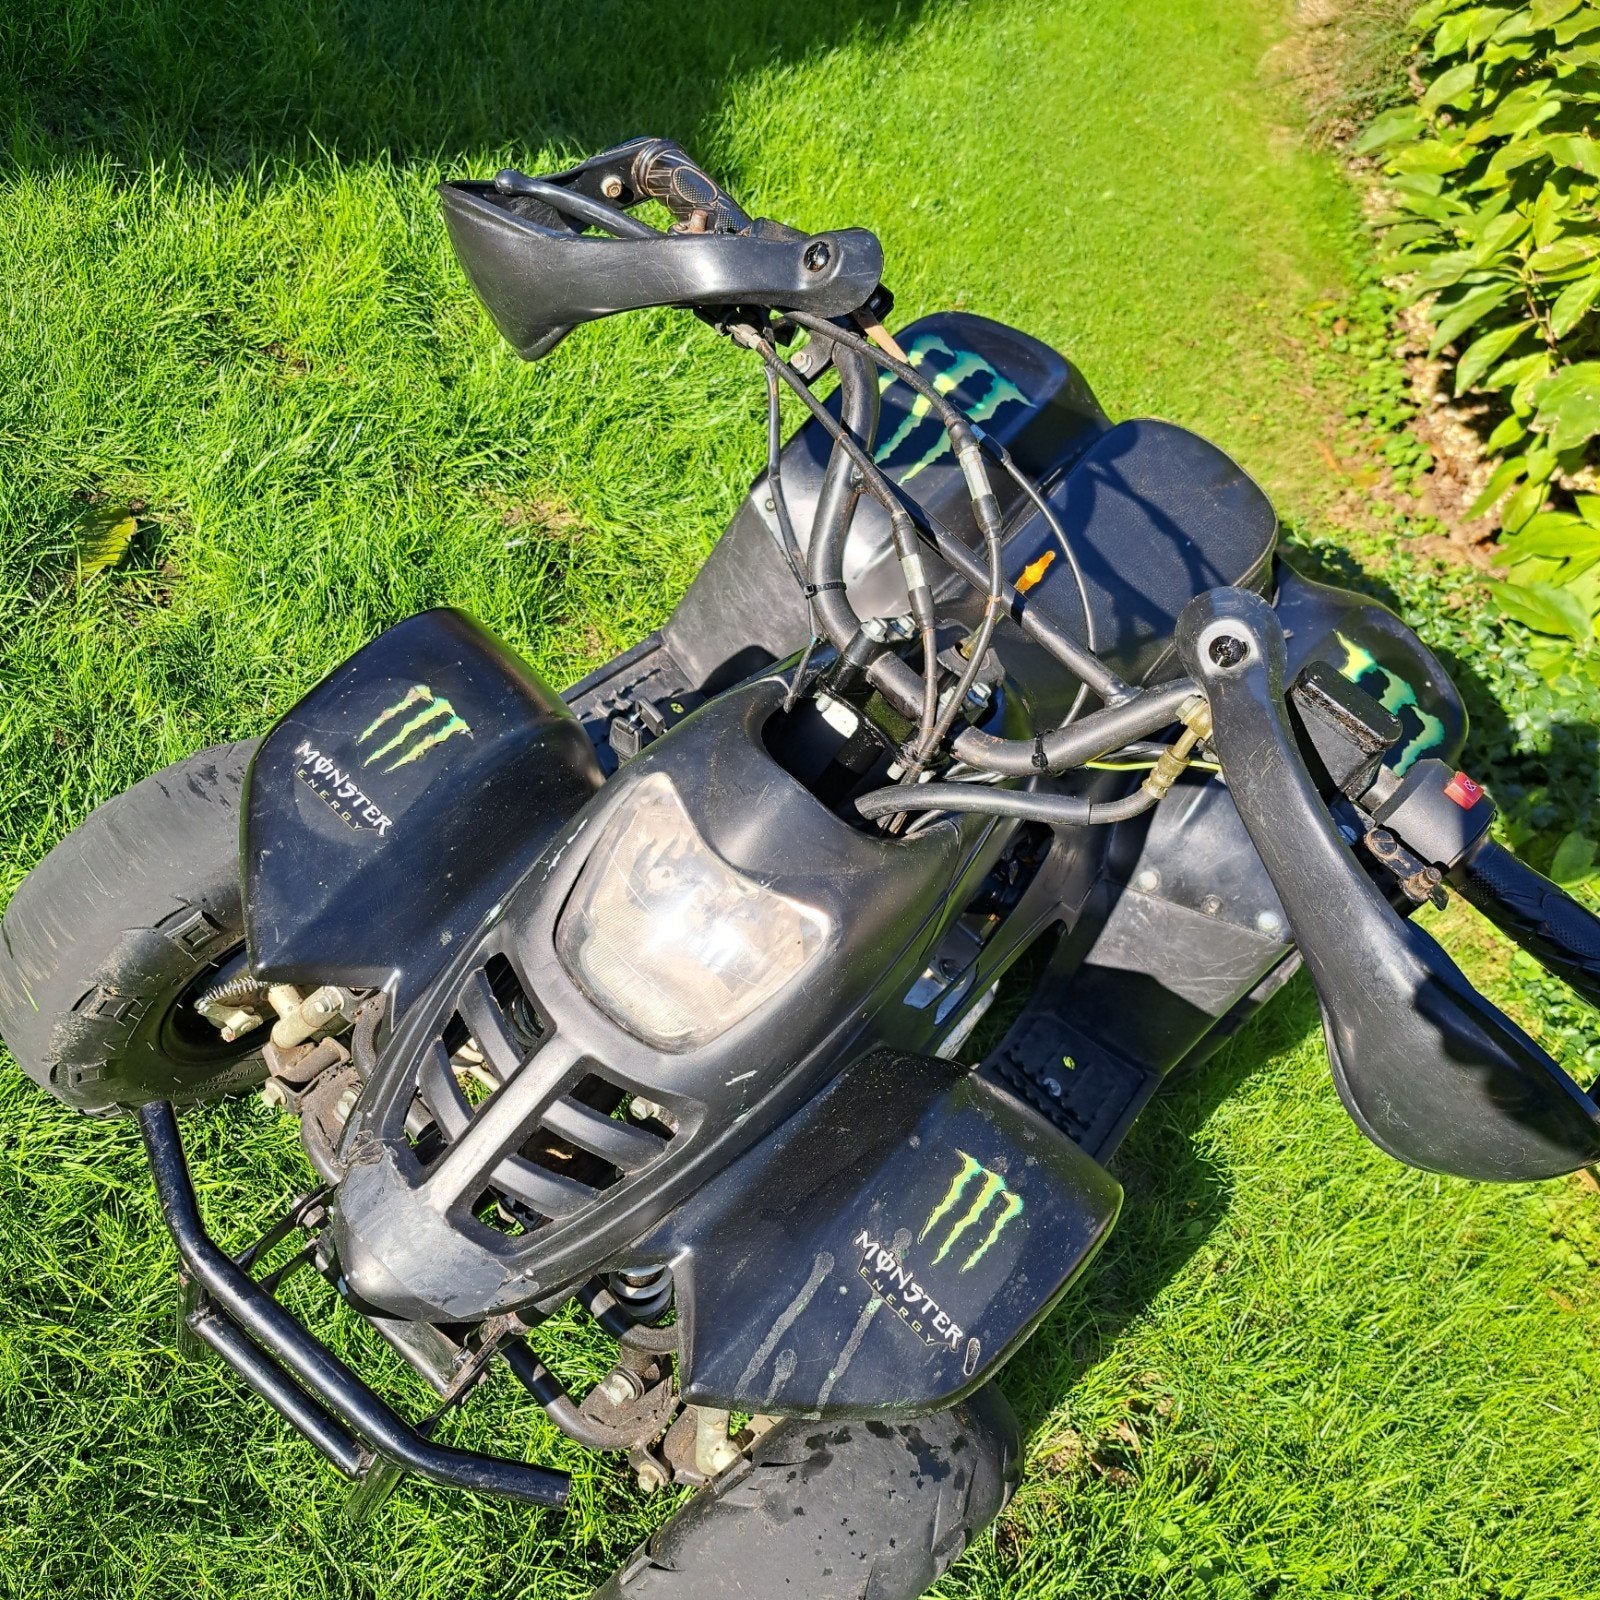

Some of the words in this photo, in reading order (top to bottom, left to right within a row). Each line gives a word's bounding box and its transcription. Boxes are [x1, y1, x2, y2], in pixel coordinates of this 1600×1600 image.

[295, 740, 393, 837] MONSTER
[296, 769, 362, 830] ENERGY
[854, 1229, 964, 1352] MONSTER
[860, 1266, 935, 1343] ENERGY
